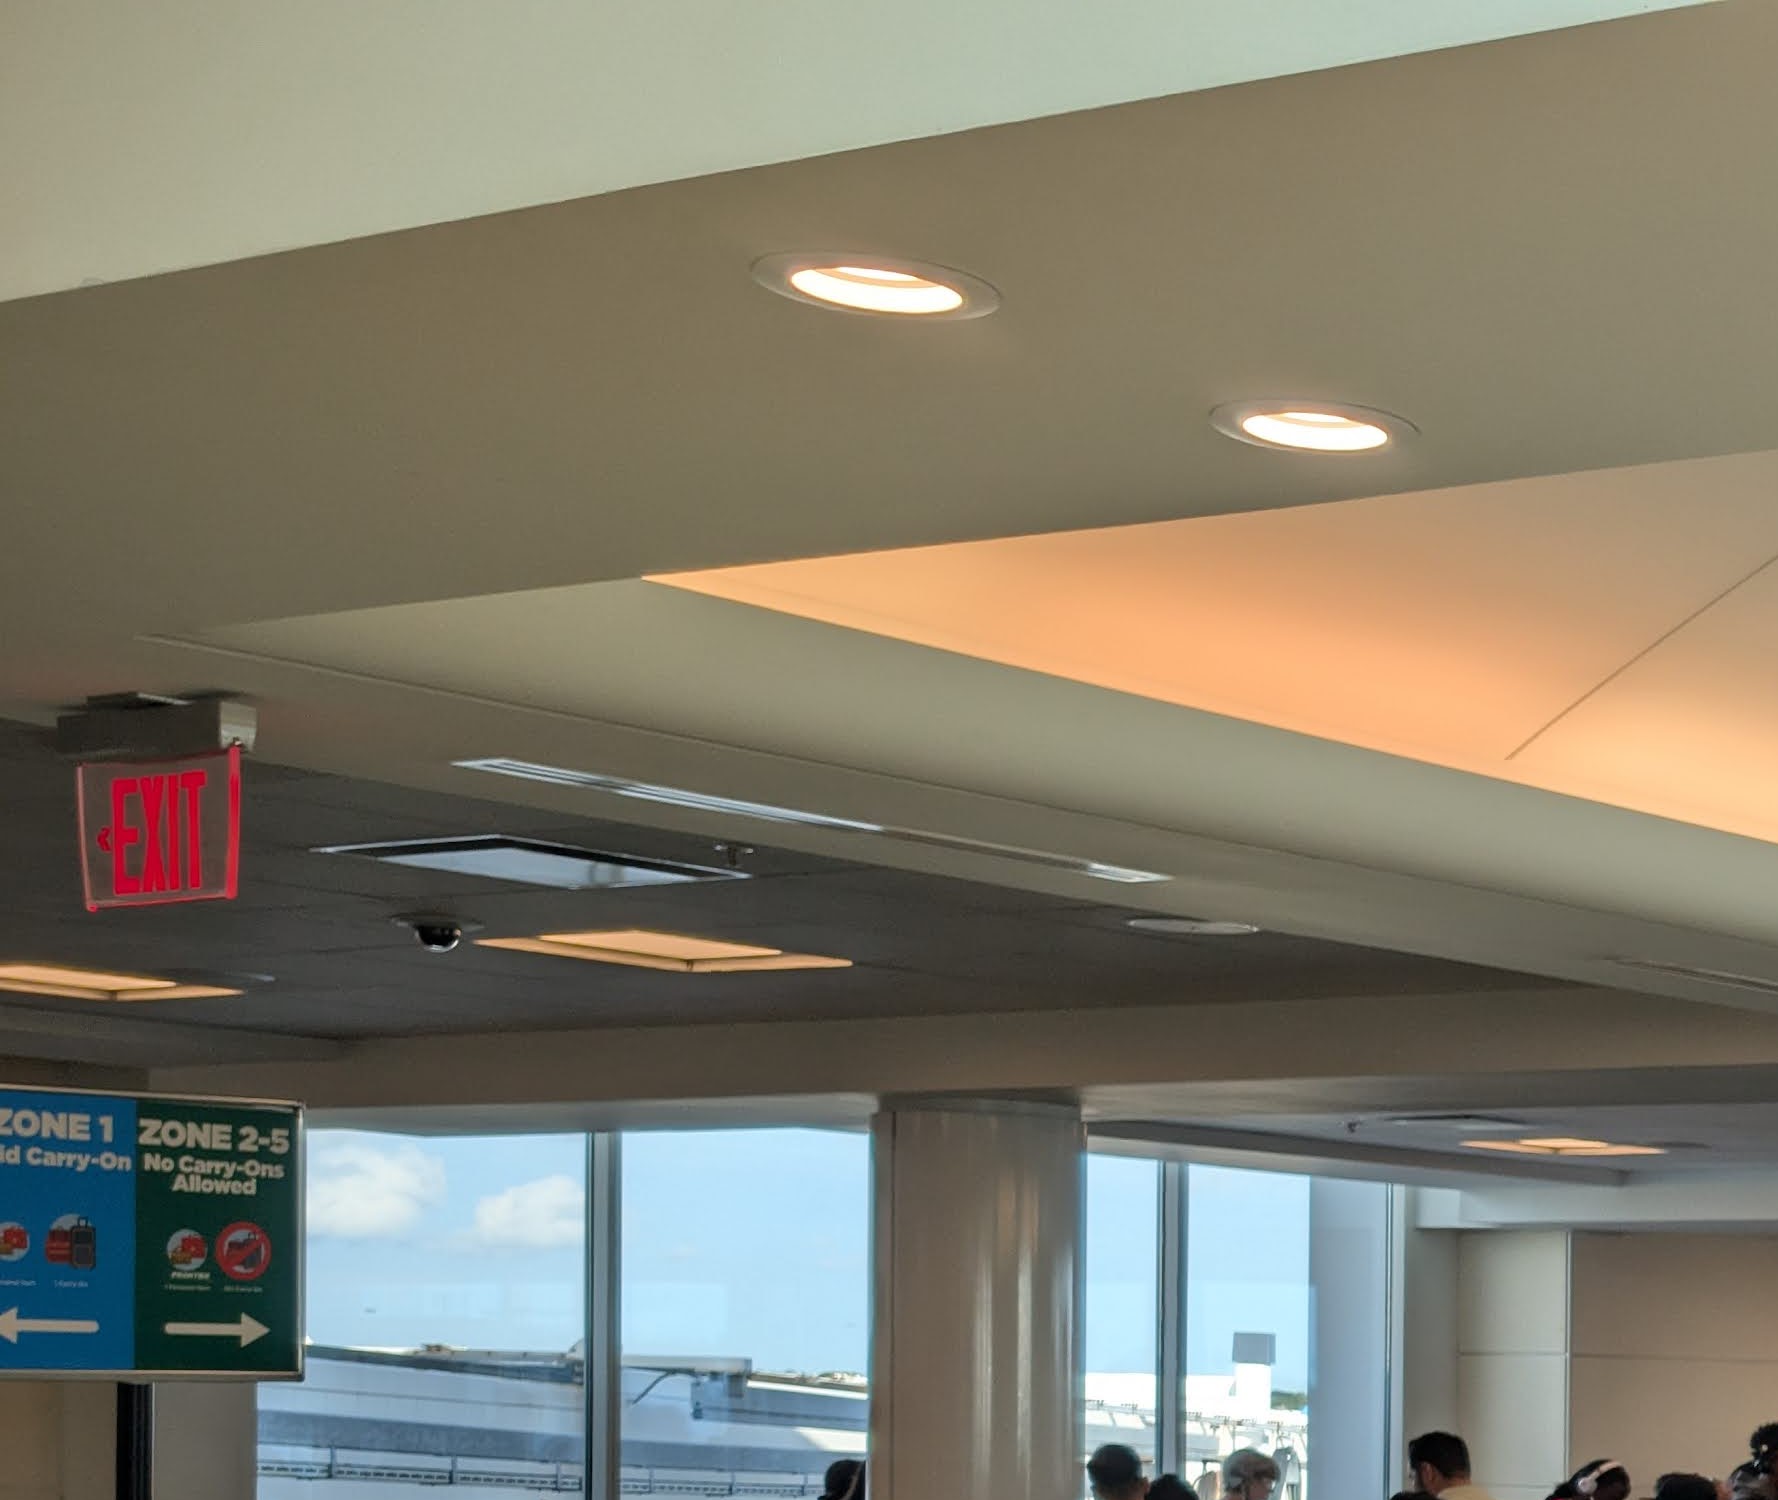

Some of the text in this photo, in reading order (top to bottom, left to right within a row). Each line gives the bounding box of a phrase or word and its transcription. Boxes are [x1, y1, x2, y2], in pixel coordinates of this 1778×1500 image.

[112, 771, 207, 895] EXIT
[0, 1108, 113, 1143] ZONE 1
[139, 1118, 289, 1154] ZONE 2-5
[26, 1147, 131, 1172] Carry-On
[144, 1153, 285, 1178] No Carry-Ons
[172, 1173, 257, 1195] Allowed
